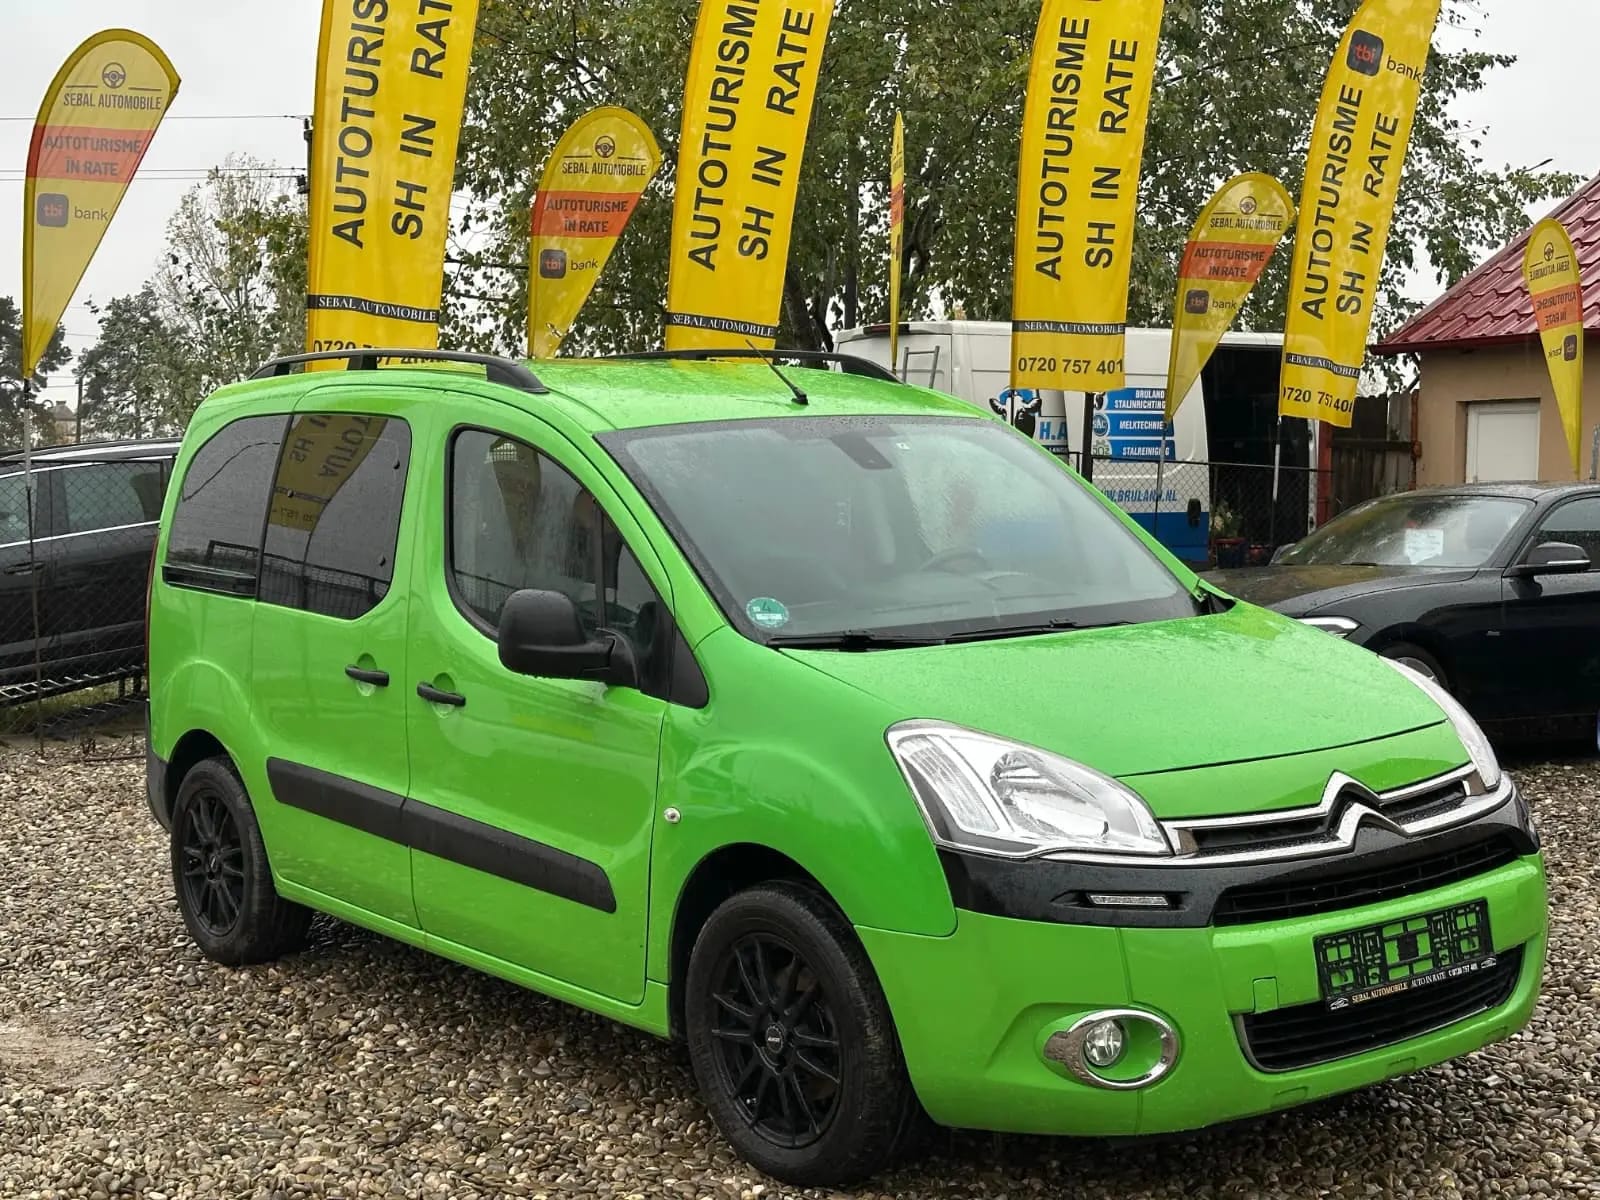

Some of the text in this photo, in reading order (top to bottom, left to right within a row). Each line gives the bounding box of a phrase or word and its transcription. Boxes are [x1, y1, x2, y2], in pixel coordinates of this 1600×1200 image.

[1354, 43, 1422, 82] tbi bank
[63, 92, 163, 111] SEBAL AUTOMOBILE
[332, 0, 389, 249] AUTOTURIS
[391, 0, 453, 240] SH IN RAT
[688, 0, 760, 272] AUTOTURISM
[737, 8, 814, 261] SH IN RATE
[44, 135, 142, 155] AUTOTURISME
[1035, 16, 1090, 281] AUTOTURISME
[1084, 38, 1139, 269] SH IN RATE
[83, 160, 120, 176] RATE
[562, 162, 647, 176] SEBAL AUTOMOBILE
[545, 199, 629, 213] AUTOTURISME
[1301, 84, 1363, 321] AUTOTURISME
[42, 203, 109, 222] tbi bank
[1335, 111, 1400, 315] SH IN RATE
[579, 220, 609, 233] RATE
[1209, 217, 1283, 231] SEBAL AUTOMOBILE
[1194, 247, 1266, 262] AUTOTURISME
[570, 259, 599, 271] bank
[1221, 266, 1248, 278] RATE
[318, 296, 437, 321] SEBAL AUTOMOBILE
[1211, 298, 1237, 310] bank
[672, 314, 774, 337] SEBAL AUTOMOBILE
[1024, 321, 1124, 334] SEBAL AUTOMOBILE
[1018, 357, 1123, 375] 0720 757 401
[1135, 389, 1165, 399] BRULAND
[1114, 399, 1166, 409] STALINRICHTING
[1119, 420, 1163, 430] MELKTECHNIE
[1122, 446, 1170, 456] STALREINIGIG
[1351, 992, 1371, 1004] SEBAL
[1371, 981, 1409, 998] AUTOMOBILE
